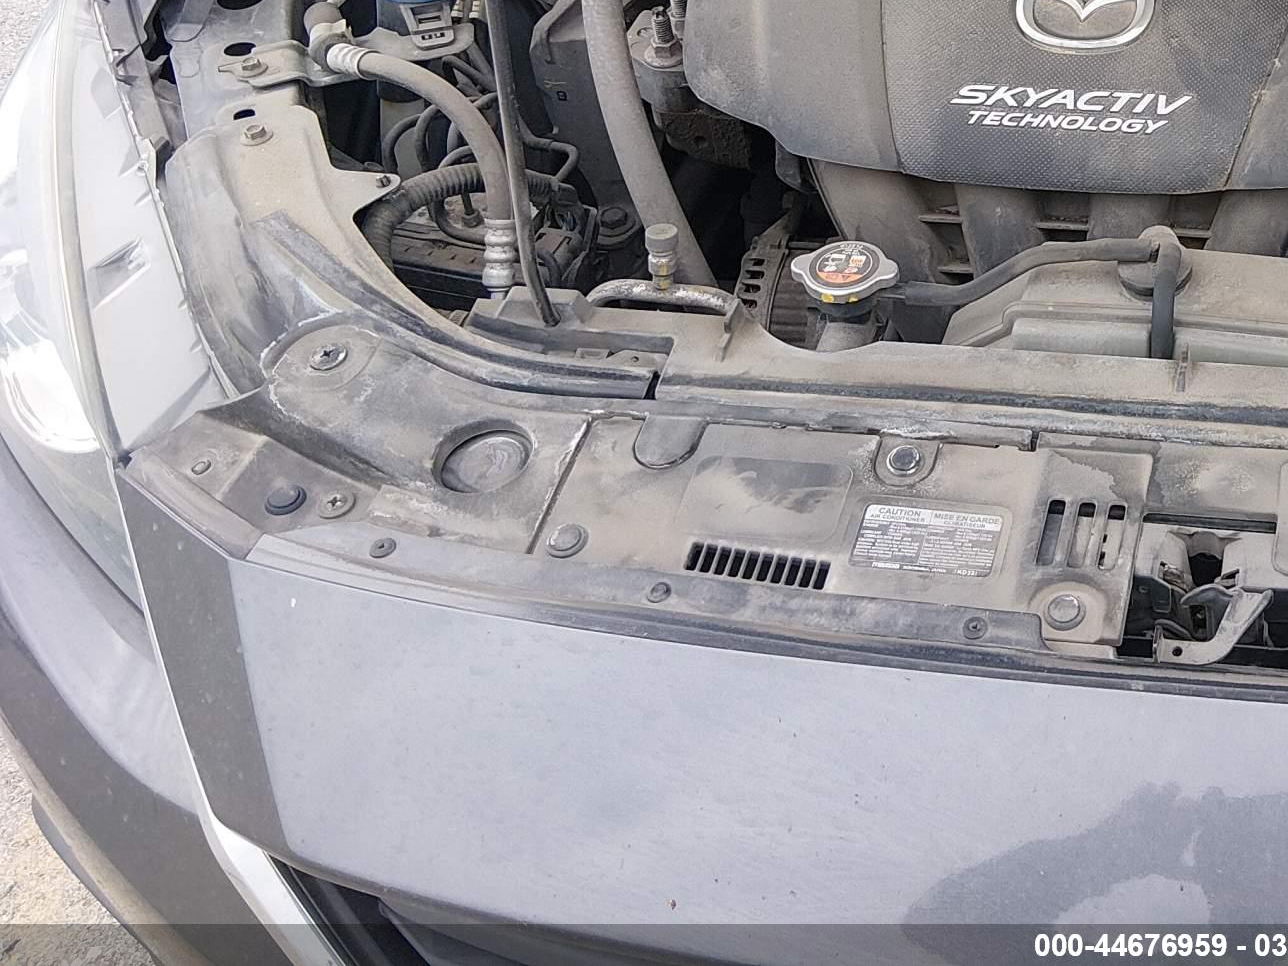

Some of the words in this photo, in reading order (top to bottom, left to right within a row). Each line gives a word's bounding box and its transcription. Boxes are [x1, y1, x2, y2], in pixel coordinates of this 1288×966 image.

[950, 84, 1193, 115] SKYACTIV
[967, 110, 1168, 134] TECHNOLOGY
[878, 507, 922, 517] CAUTION
[882, 514, 925, 523] CONDITIONER
[934, 513, 954, 521] MISE
[956, 514, 969, 522] EN
[969, 515, 1001, 525] GARDE
